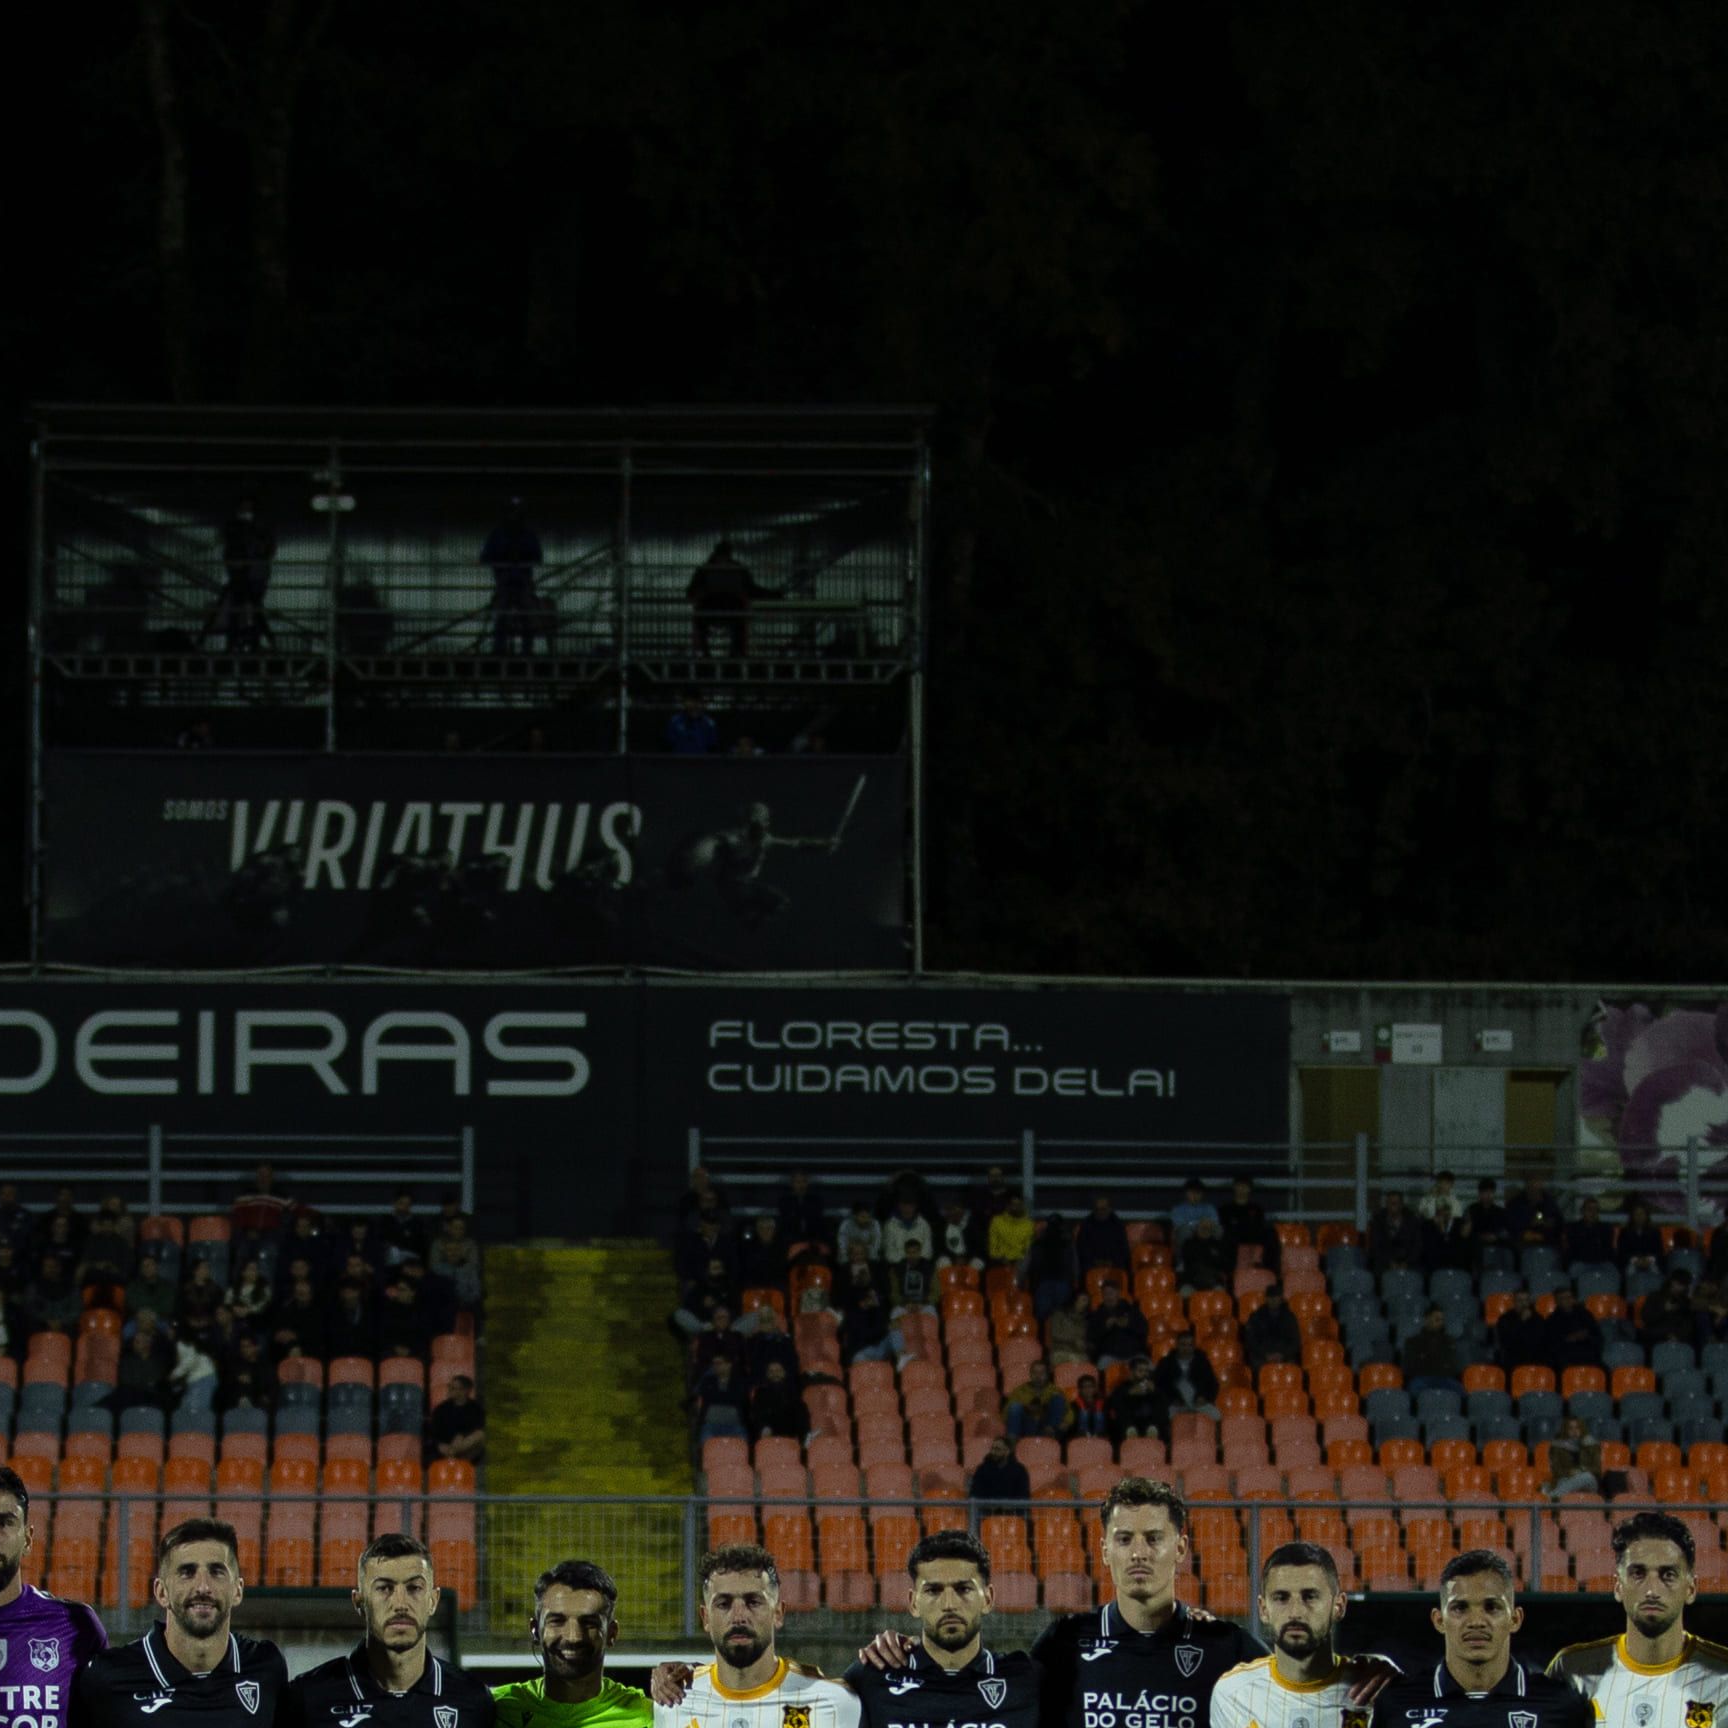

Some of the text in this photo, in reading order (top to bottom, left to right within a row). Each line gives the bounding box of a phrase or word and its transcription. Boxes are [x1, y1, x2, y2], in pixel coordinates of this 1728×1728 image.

[709, 1020, 1044, 1053] FLORESTA...
[707, 1063, 1177, 1098] CUIDAMOS DELA!
[1083, 1689, 1198, 1714] PALÁCIO
[1405, 1708, 1449, 1720] C.117
[1084, 1711, 1116, 1728] DO
